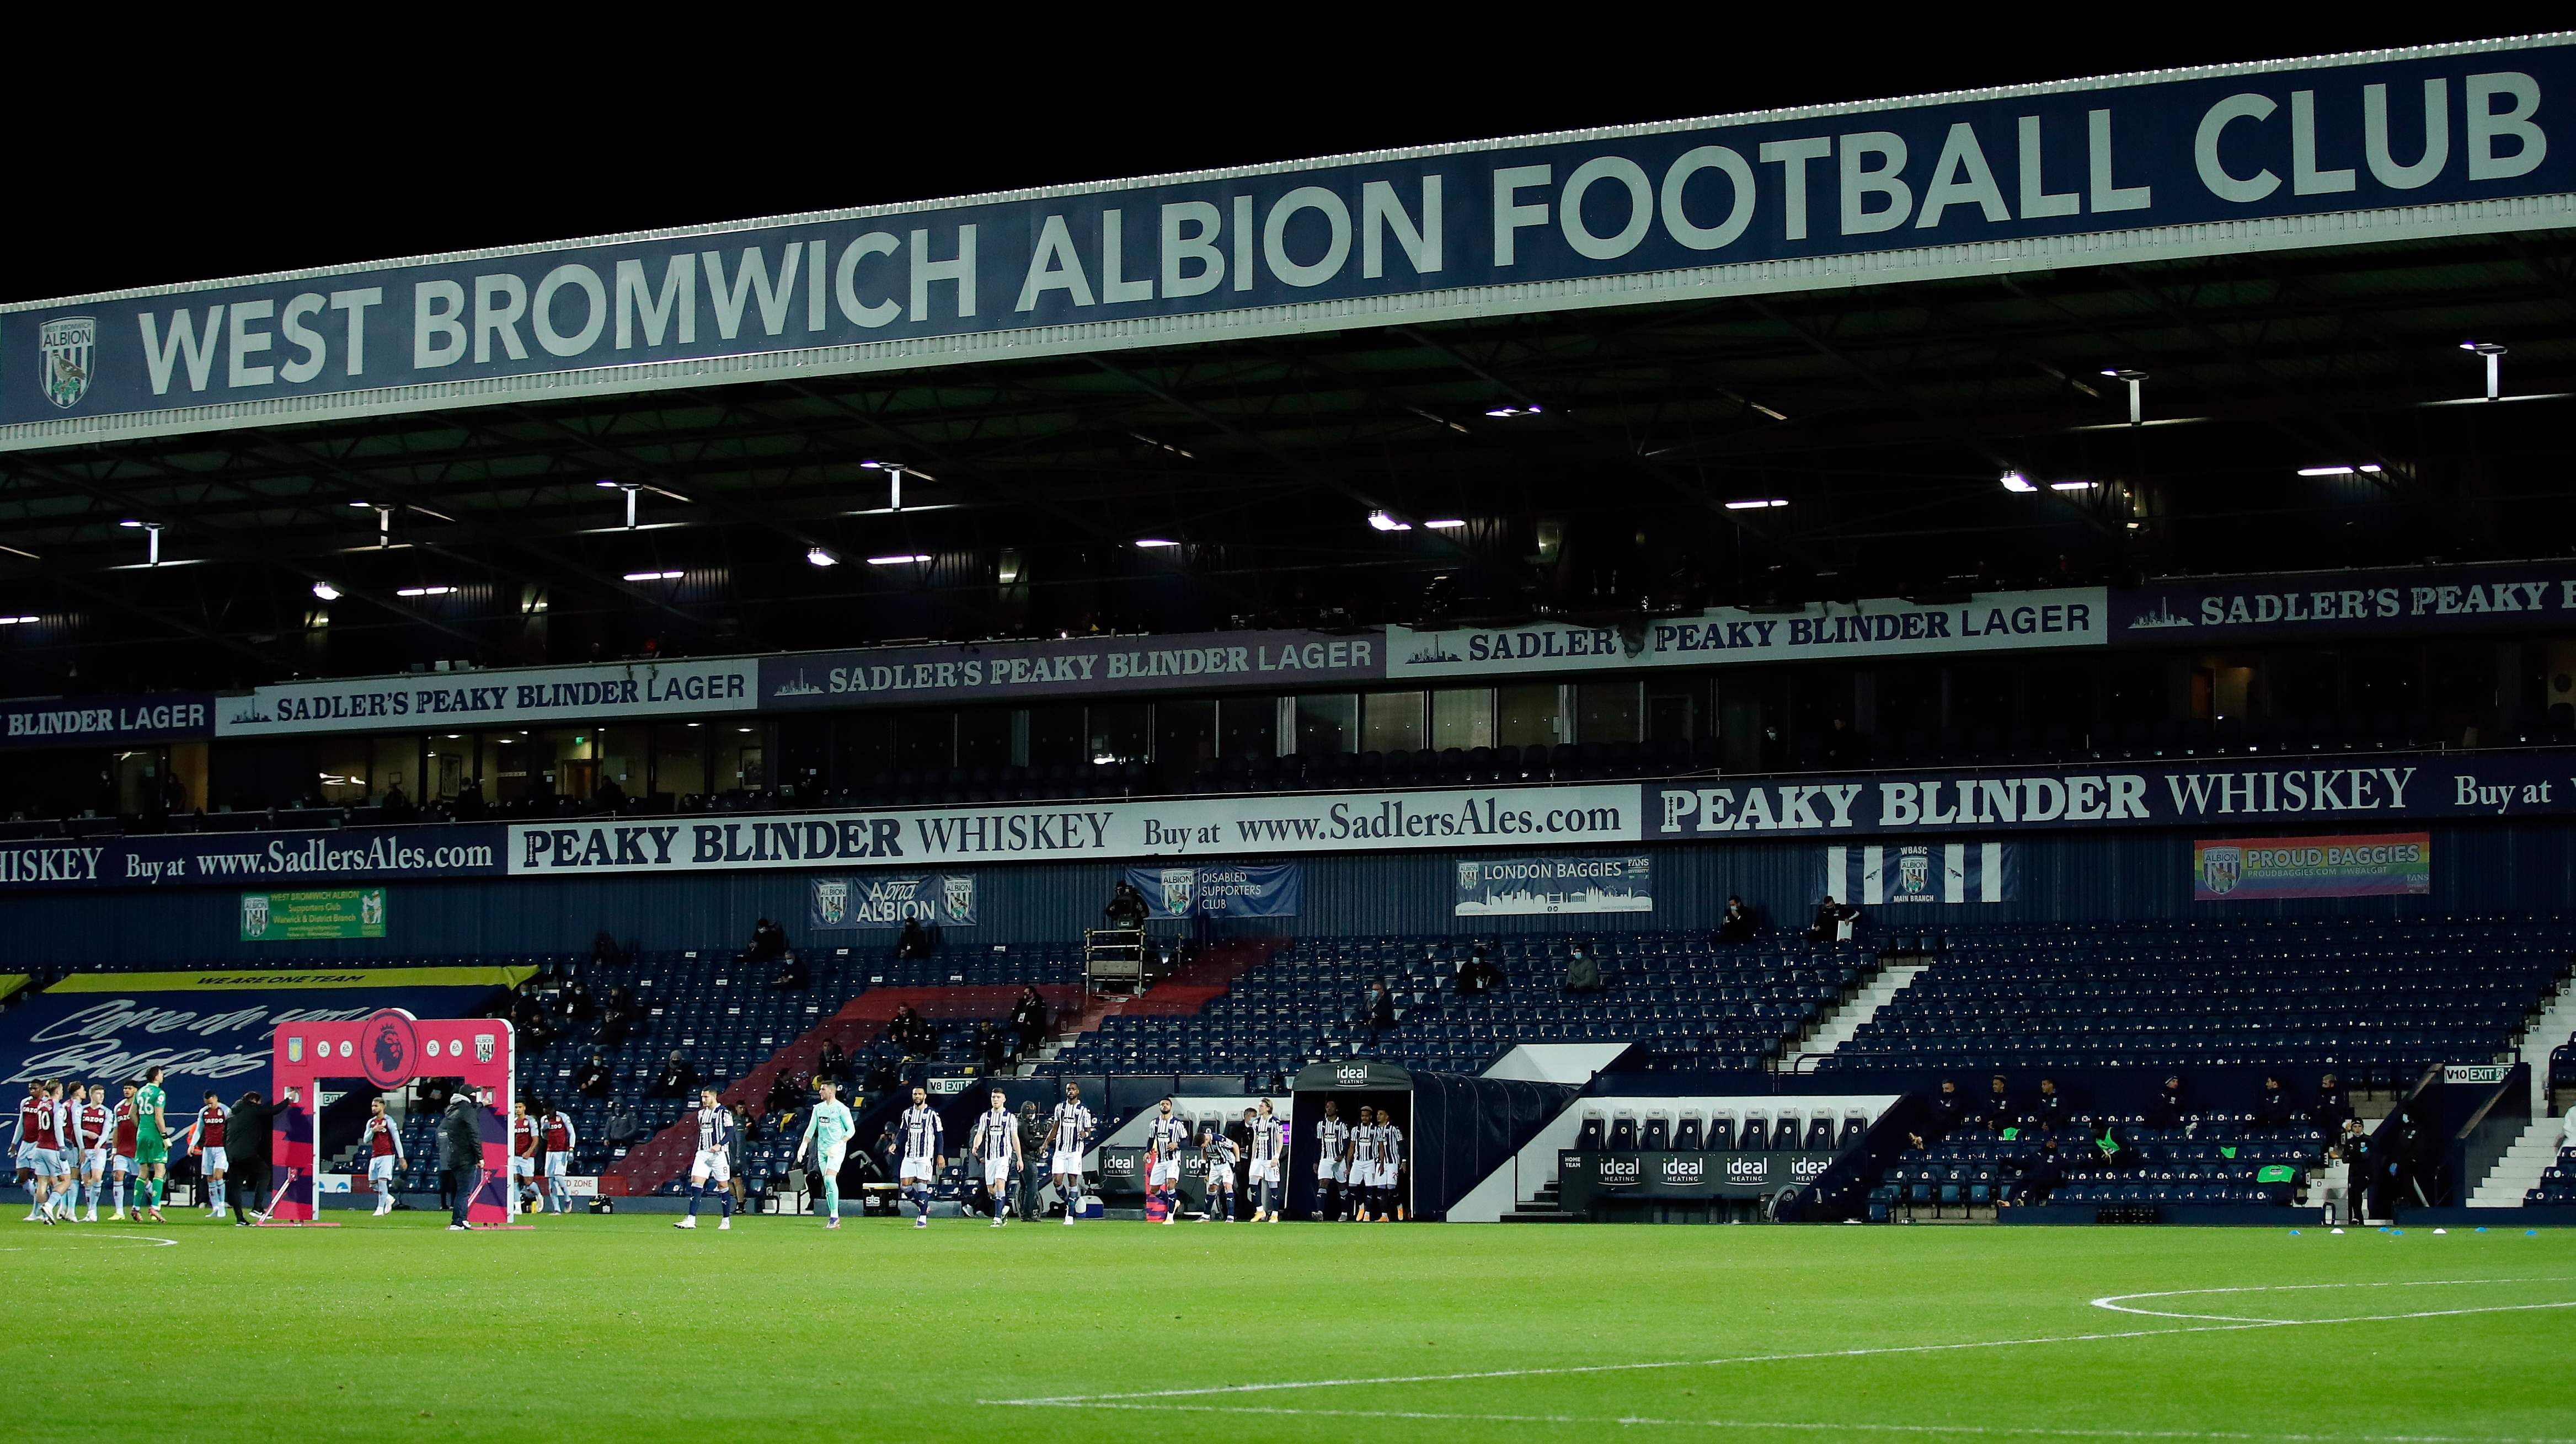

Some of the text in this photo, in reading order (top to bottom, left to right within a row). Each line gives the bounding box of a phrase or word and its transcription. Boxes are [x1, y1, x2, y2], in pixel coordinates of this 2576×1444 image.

[138, 71, 2547, 395] WEST BROMWICH ALBION FOOTBALL CLUB
[44, 329, 91, 347] ALBION
[2201, 588, 2399, 625] SADLER'S
[2411, 582, 2549, 616] PEAKY
[1655, 620, 1777, 651] PEAKY
[1789, 611, 1950, 645] BLINDER
[1963, 604, 2089, 636] LAGER
[829, 640, 1371, 693] SADLER'S PEAKY BLINDER LAGER
[277, 674, 744, 721] SADLER'S PEAKY BLINDER LAGER
[8, 704, 205, 736] BLINDER LAGER
[1661, 784, 1862, 833] PEAKY
[1879, 773, 2150, 826] BLINDER
[2165, 768, 2417, 815] WHISKEY
[2455, 776, 2516, 814] Buy
[2522, 780, 2552, 803] at
[523, 798, 1621, 868] PEAKY BLINDER WHISKEY Buy at www.SadlersAles.com
[126, 854, 163, 884] Buy
[167, 858, 185, 876] at
[197, 835, 493, 875] www.SadlersAles.com
[1900, 846, 1927, 855] WBASC
[2247, 844, 2419, 868] PROUD BAGGIES
[1163, 875, 1192, 884] ALBION
[1202, 872, 1247, 883] DISABLED
[1484, 862, 1622, 880] LONDON BAGGIES
[291, 892, 332, 900] BROMWICH
[333, 891, 360, 899] ALBION
[869, 881, 919, 911] Apna
[1202, 885, 1261, 896] SUPPORTERS
[247, 900, 266, 909] ALBION
[856, 900, 935, 922] ALBION
[1202, 899, 1226, 909] CLUB
[1337, 1065, 1367, 1078] ideal
[2446, 1069, 2494, 1080] V10 EXIT
[946, 1082, 964, 1090] EXIT
[137, 1096, 154, 1115] 26
[325, 1094, 339, 1103] EXIT
[38, 1110, 50, 1130] 10
[1104, 1155, 1134, 1168] ideal
[1600, 1158, 1639, 1174] ideal
[1663, 1157, 1703, 1174] ideal
[1727, 1157, 1767, 1174] ideal
